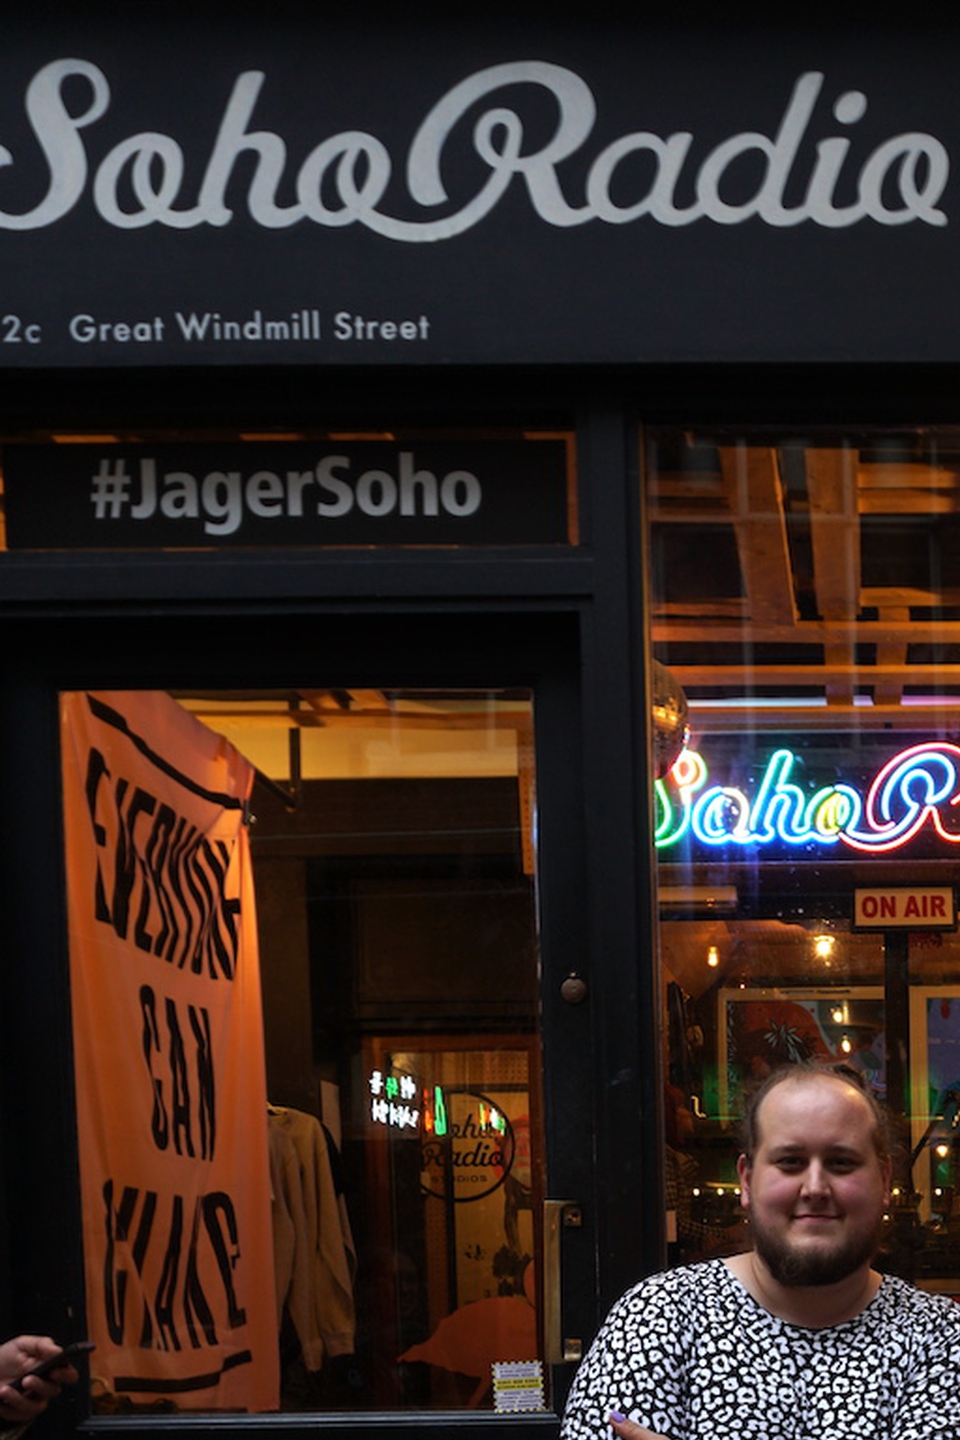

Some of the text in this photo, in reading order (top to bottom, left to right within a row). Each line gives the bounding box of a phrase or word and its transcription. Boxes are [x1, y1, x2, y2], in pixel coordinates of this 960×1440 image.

[69, 314, 165, 342] Great
[175, 310, 321, 341] Windmill
[334, 311, 430, 341] Street
[90, 452, 482, 535] #JagerSoho
[862, 895, 946, 918] ON AIR
[139, 984, 216, 1162] CAN
